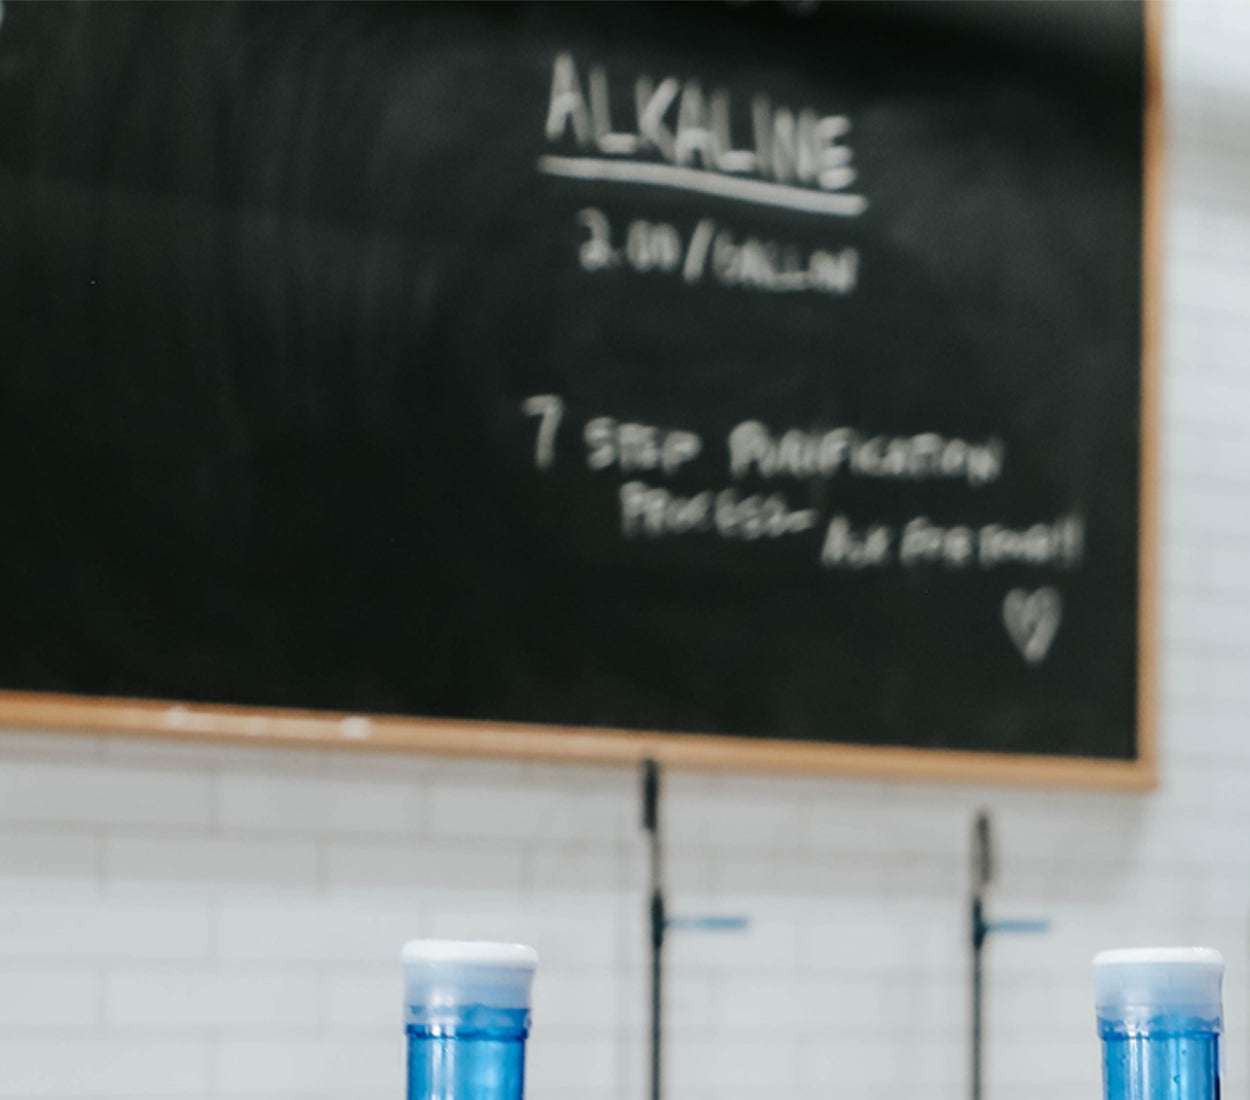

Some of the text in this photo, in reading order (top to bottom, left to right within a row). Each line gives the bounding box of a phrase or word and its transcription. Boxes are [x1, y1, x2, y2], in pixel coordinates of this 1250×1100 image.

[545, 50, 858, 191] ALKALINE
[522, 393, 1002, 486] 7 STEP PURIFICATION
